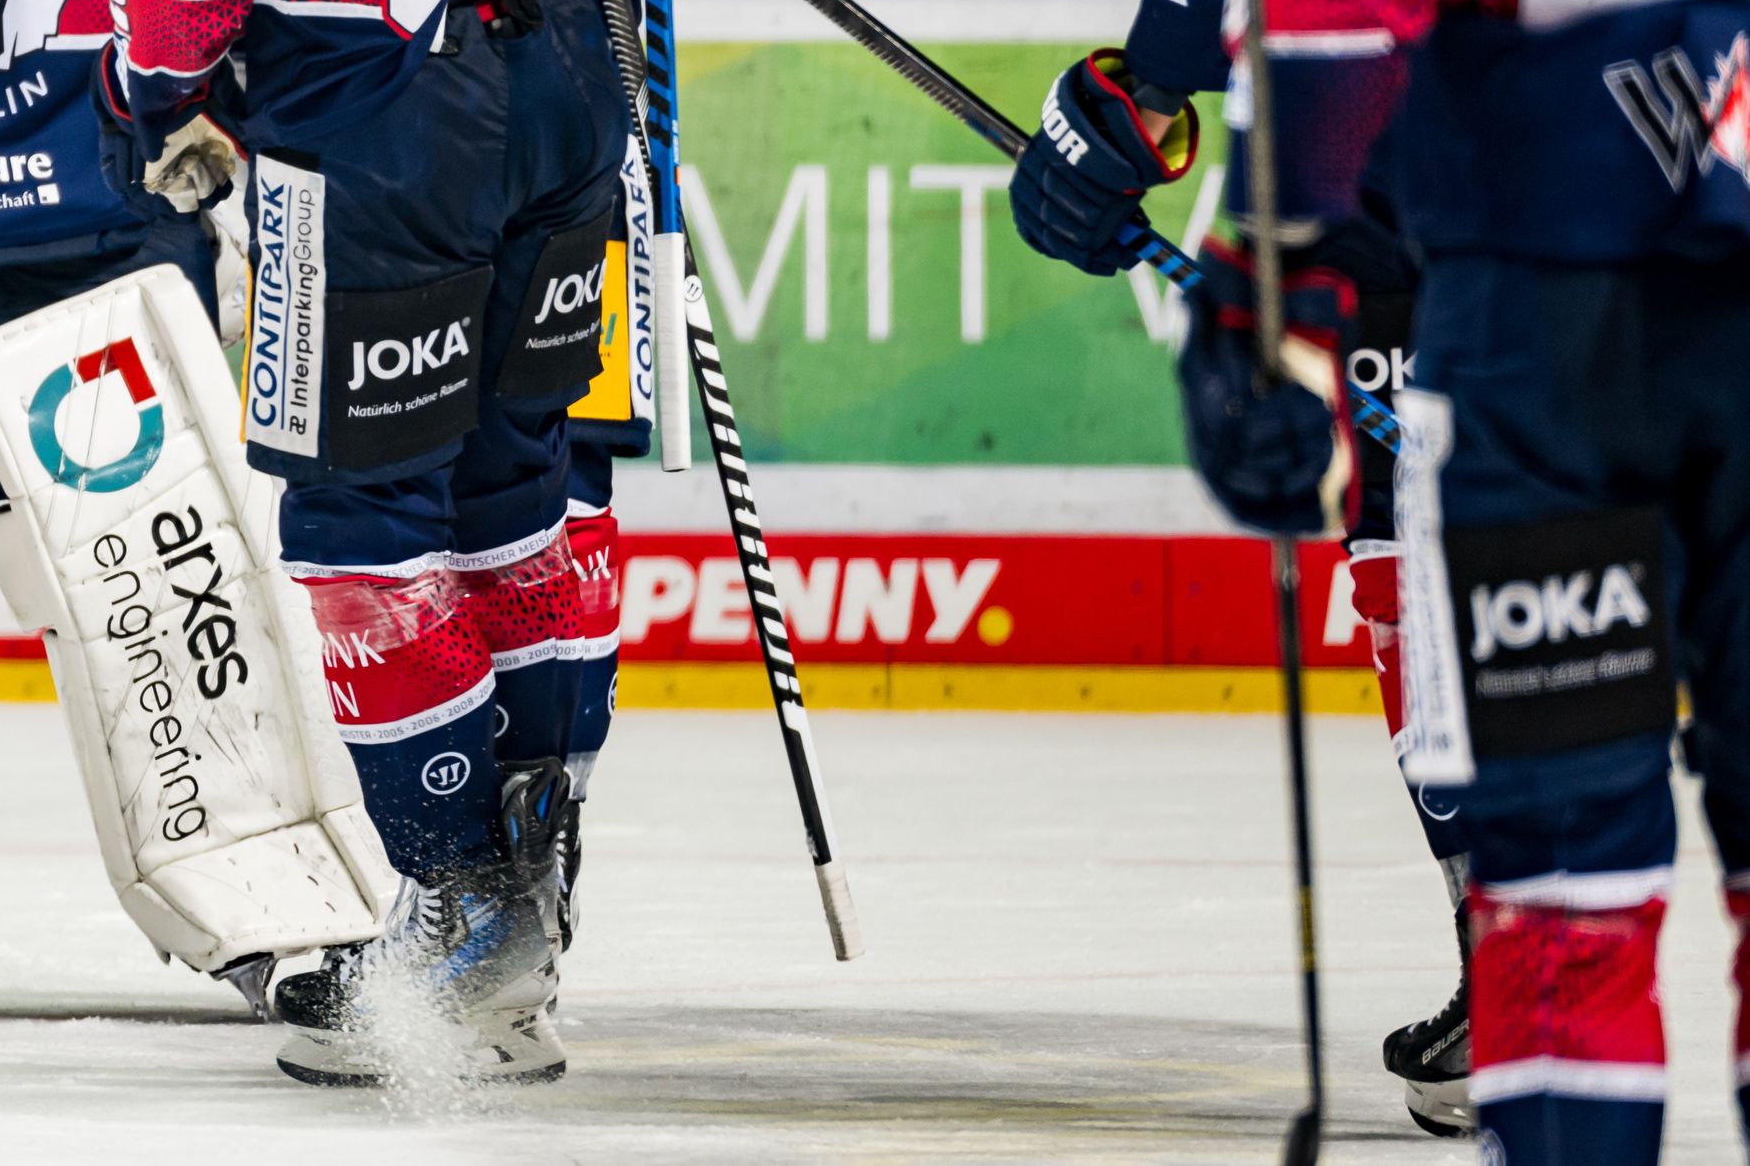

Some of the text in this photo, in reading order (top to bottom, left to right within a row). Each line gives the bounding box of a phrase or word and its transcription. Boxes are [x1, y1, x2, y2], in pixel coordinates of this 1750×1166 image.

[251, 175, 286, 428] CONTIPARK
[347, 320, 471, 392] JOKA
[347, 402, 403, 418] Natürlich
[405, 393, 438, 411] schöne
[449, 548, 517, 568] DEUTSCHER
[151, 505, 248, 700] arxes
[617, 556, 1014, 647] PENNY.
[1470, 563, 1651, 662] JOKA
[93, 533, 207, 842] engineering
[491, 656, 520, 669] 2008
[340, 727, 371, 741] EISTER
[377, 723, 405, 739] 2005
[411, 713, 441, 731] 2006
[448, 696, 475, 718] 2008
